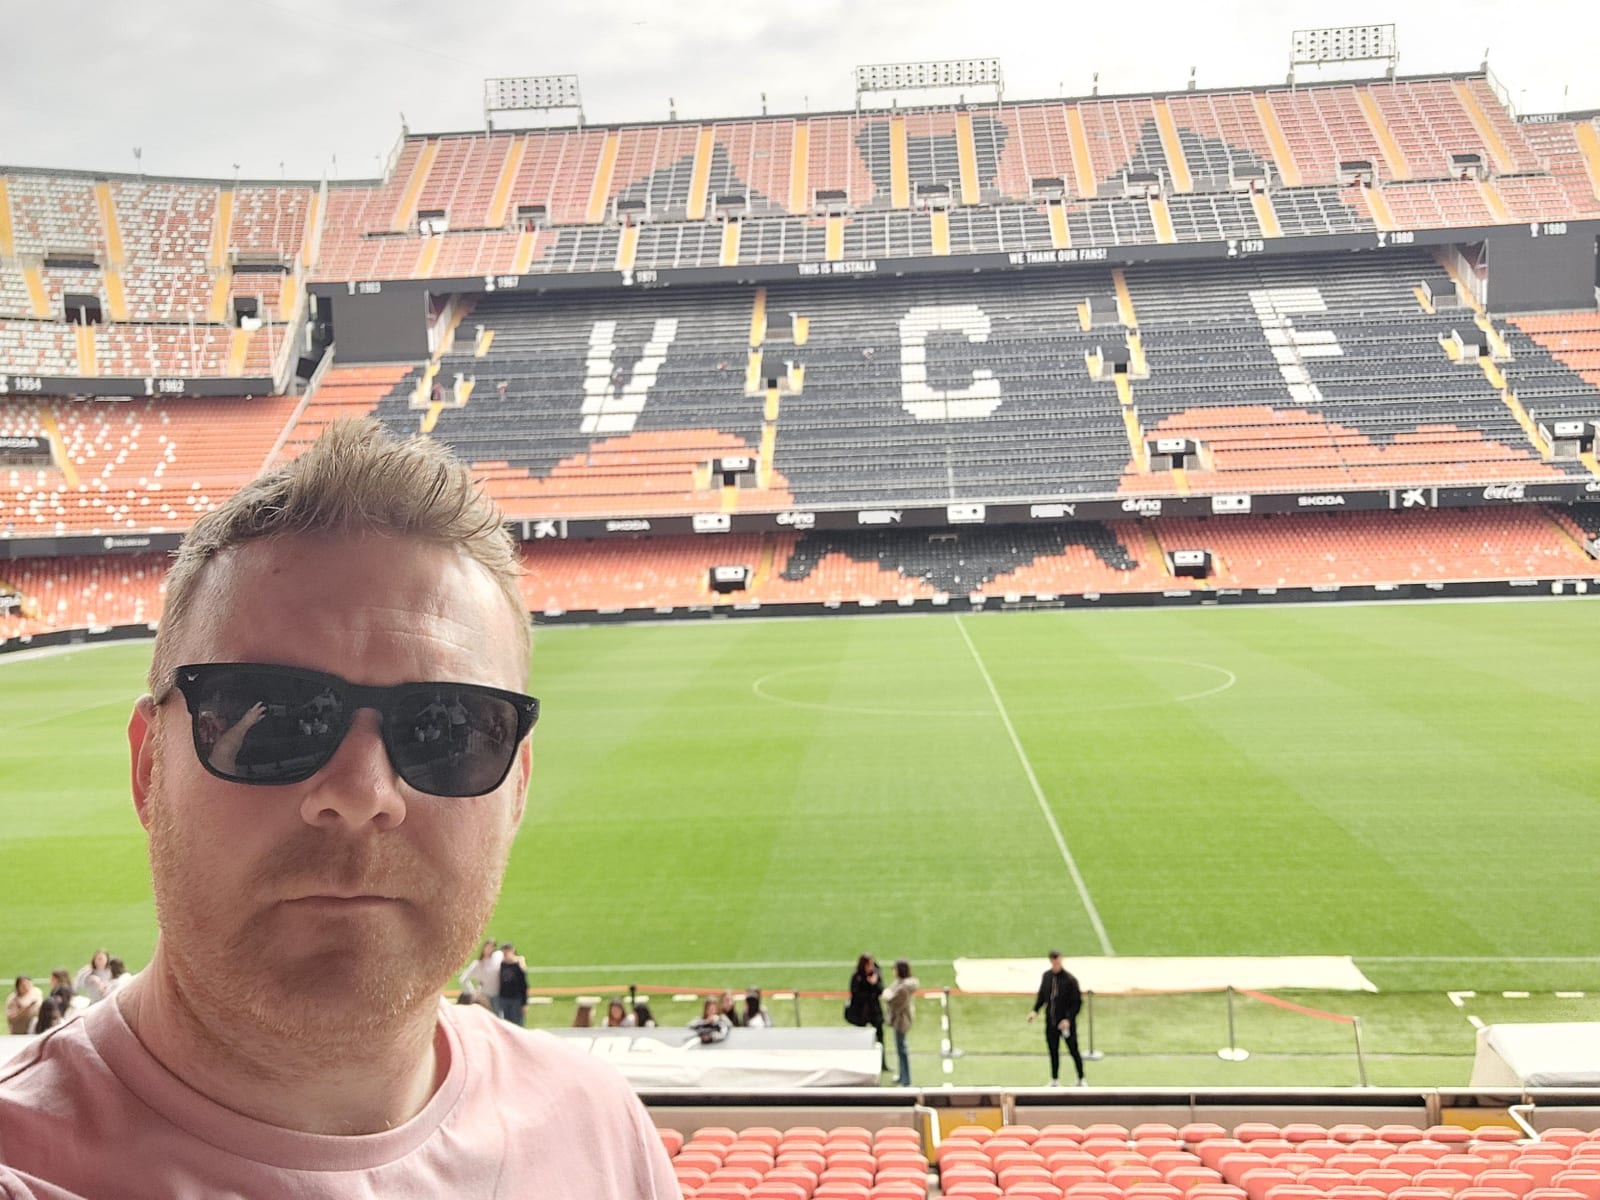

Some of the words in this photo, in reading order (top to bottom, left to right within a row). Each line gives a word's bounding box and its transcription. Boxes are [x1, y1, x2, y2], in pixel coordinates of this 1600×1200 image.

[1009, 252, 1024, 264] WE
[1026, 250, 1056, 263] THANK
[1058, 249, 1078, 261] OUR
[1080, 248, 1107, 260] FANS!
[580, 318, 678, 434] V
[900, 304, 1002, 420] C
[1248, 287, 1344, 403] F
